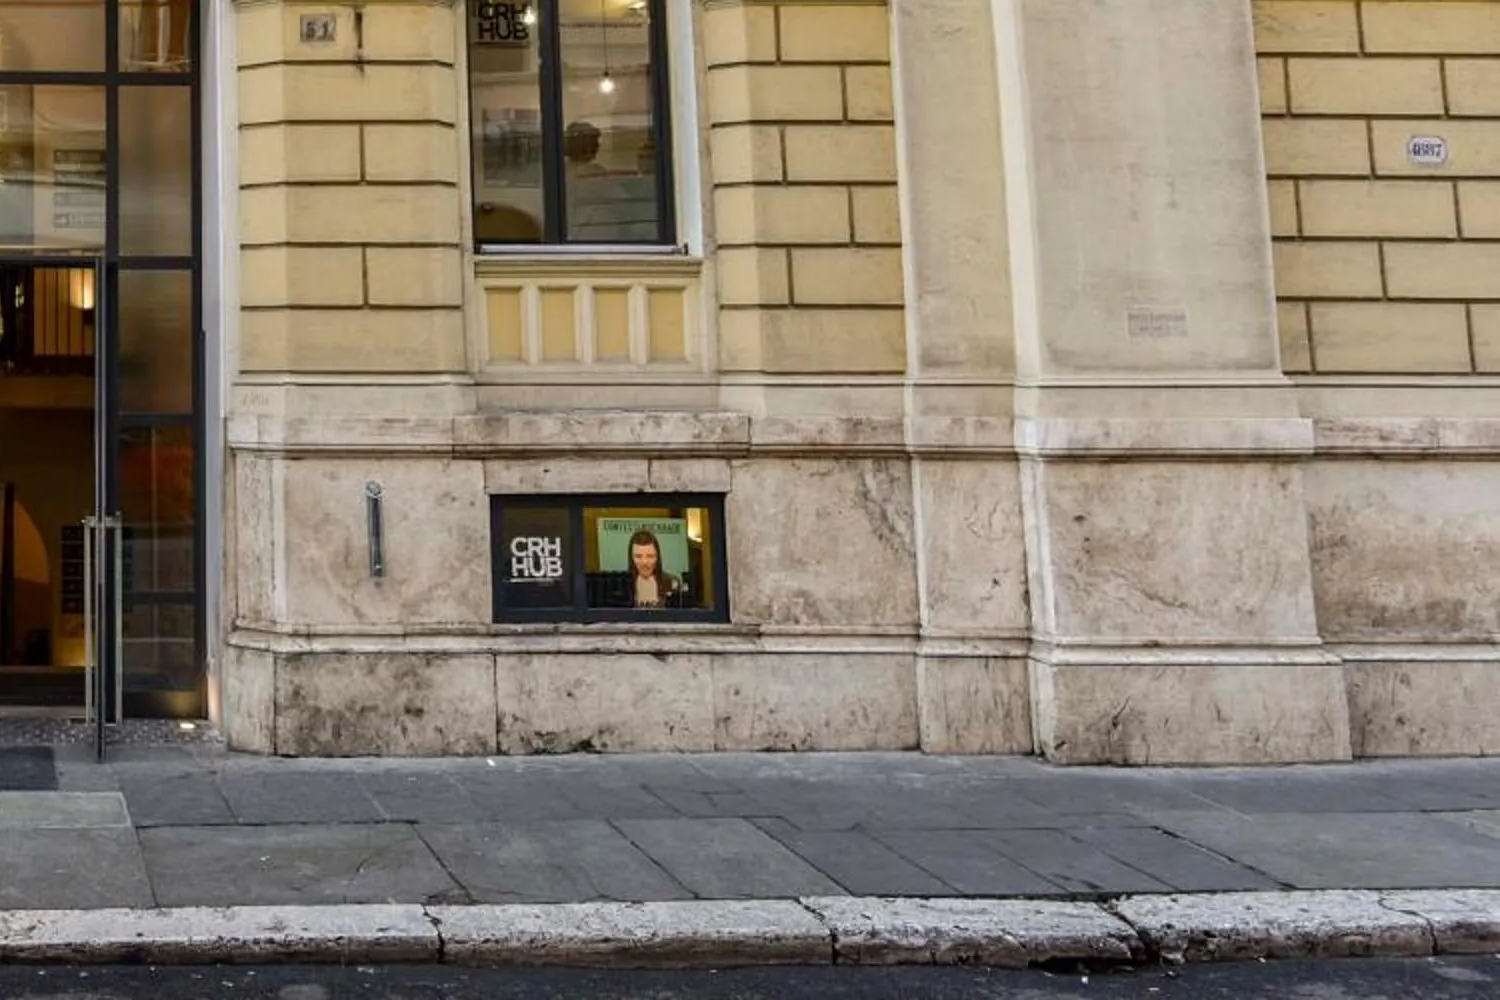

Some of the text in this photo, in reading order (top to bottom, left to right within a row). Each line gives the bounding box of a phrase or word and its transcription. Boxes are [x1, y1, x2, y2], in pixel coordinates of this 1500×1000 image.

[478, 2, 529, 21] CRH
[478, 21, 529, 41] HUB
[510, 536, 561, 557] CRH
[511, 557, 563, 577] HUB
